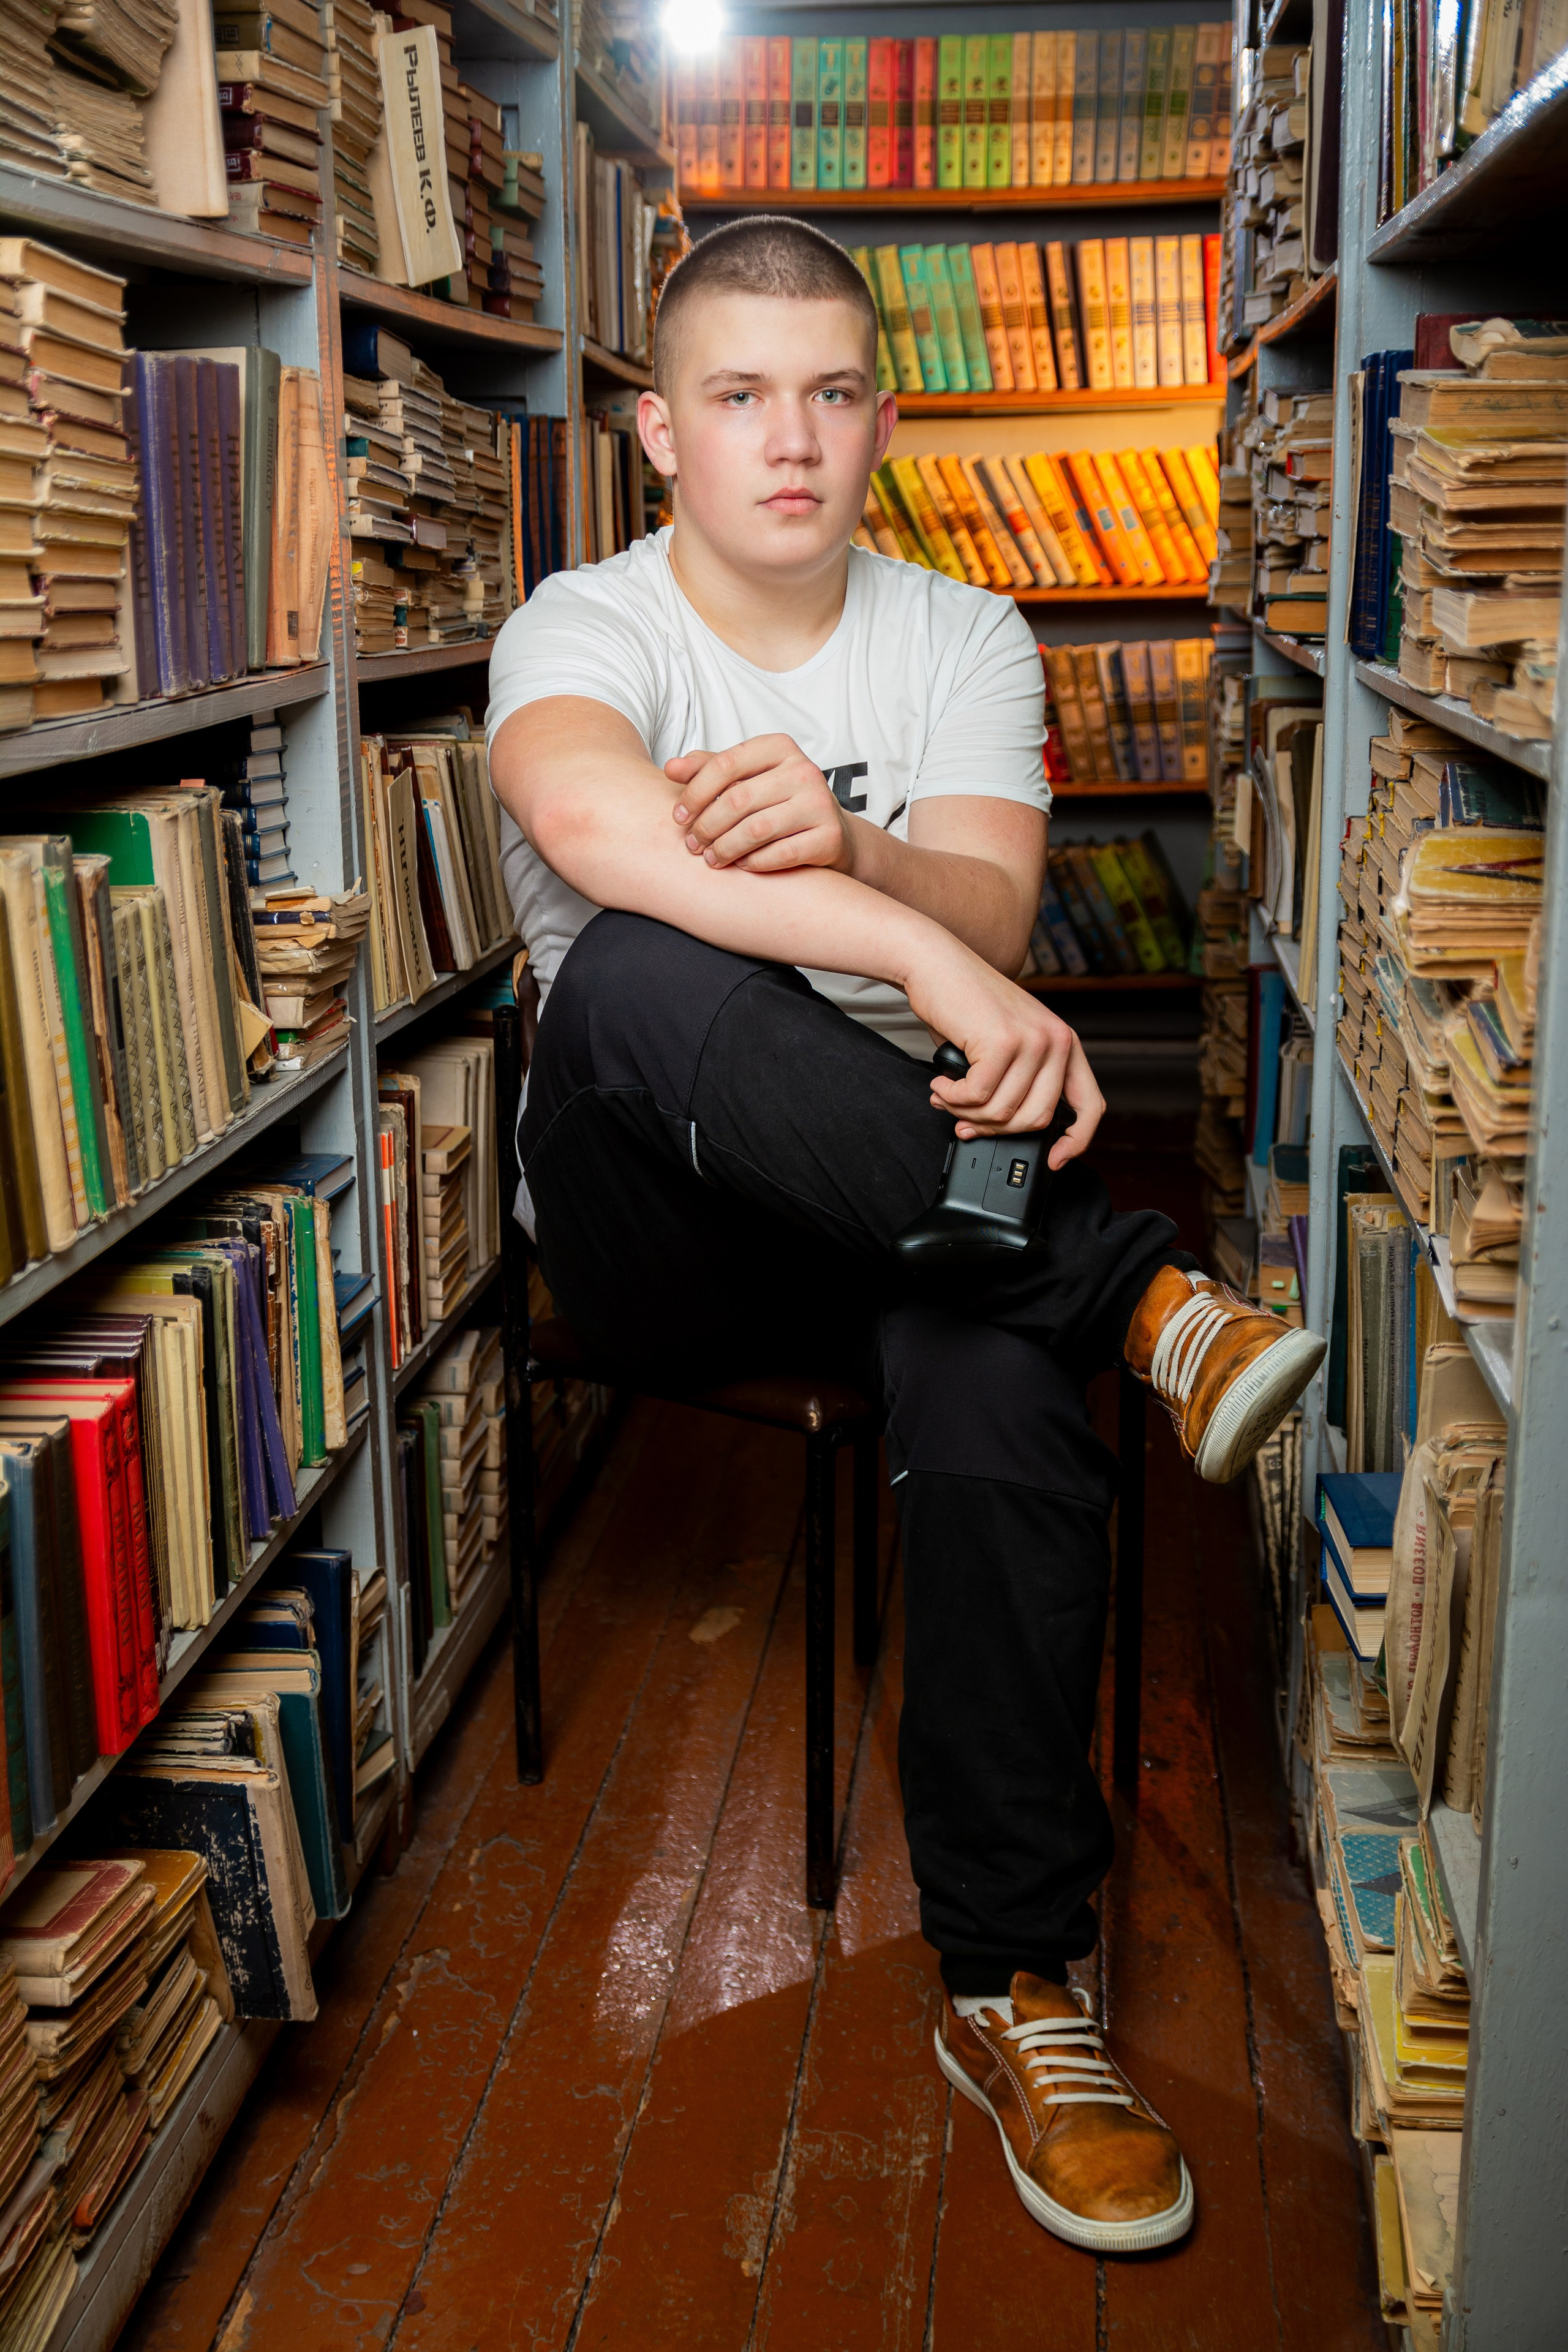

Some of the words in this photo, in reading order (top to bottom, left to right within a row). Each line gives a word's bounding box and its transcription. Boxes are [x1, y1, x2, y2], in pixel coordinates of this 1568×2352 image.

[266, 416, 274, 486] ПУШКИН
[114, 1509, 131, 1647] ПУШКИН
[133, 1501, 148, 1612] ПУШКИН
[1412, 1523, 1427, 1585] ПОЭЗИЯ
